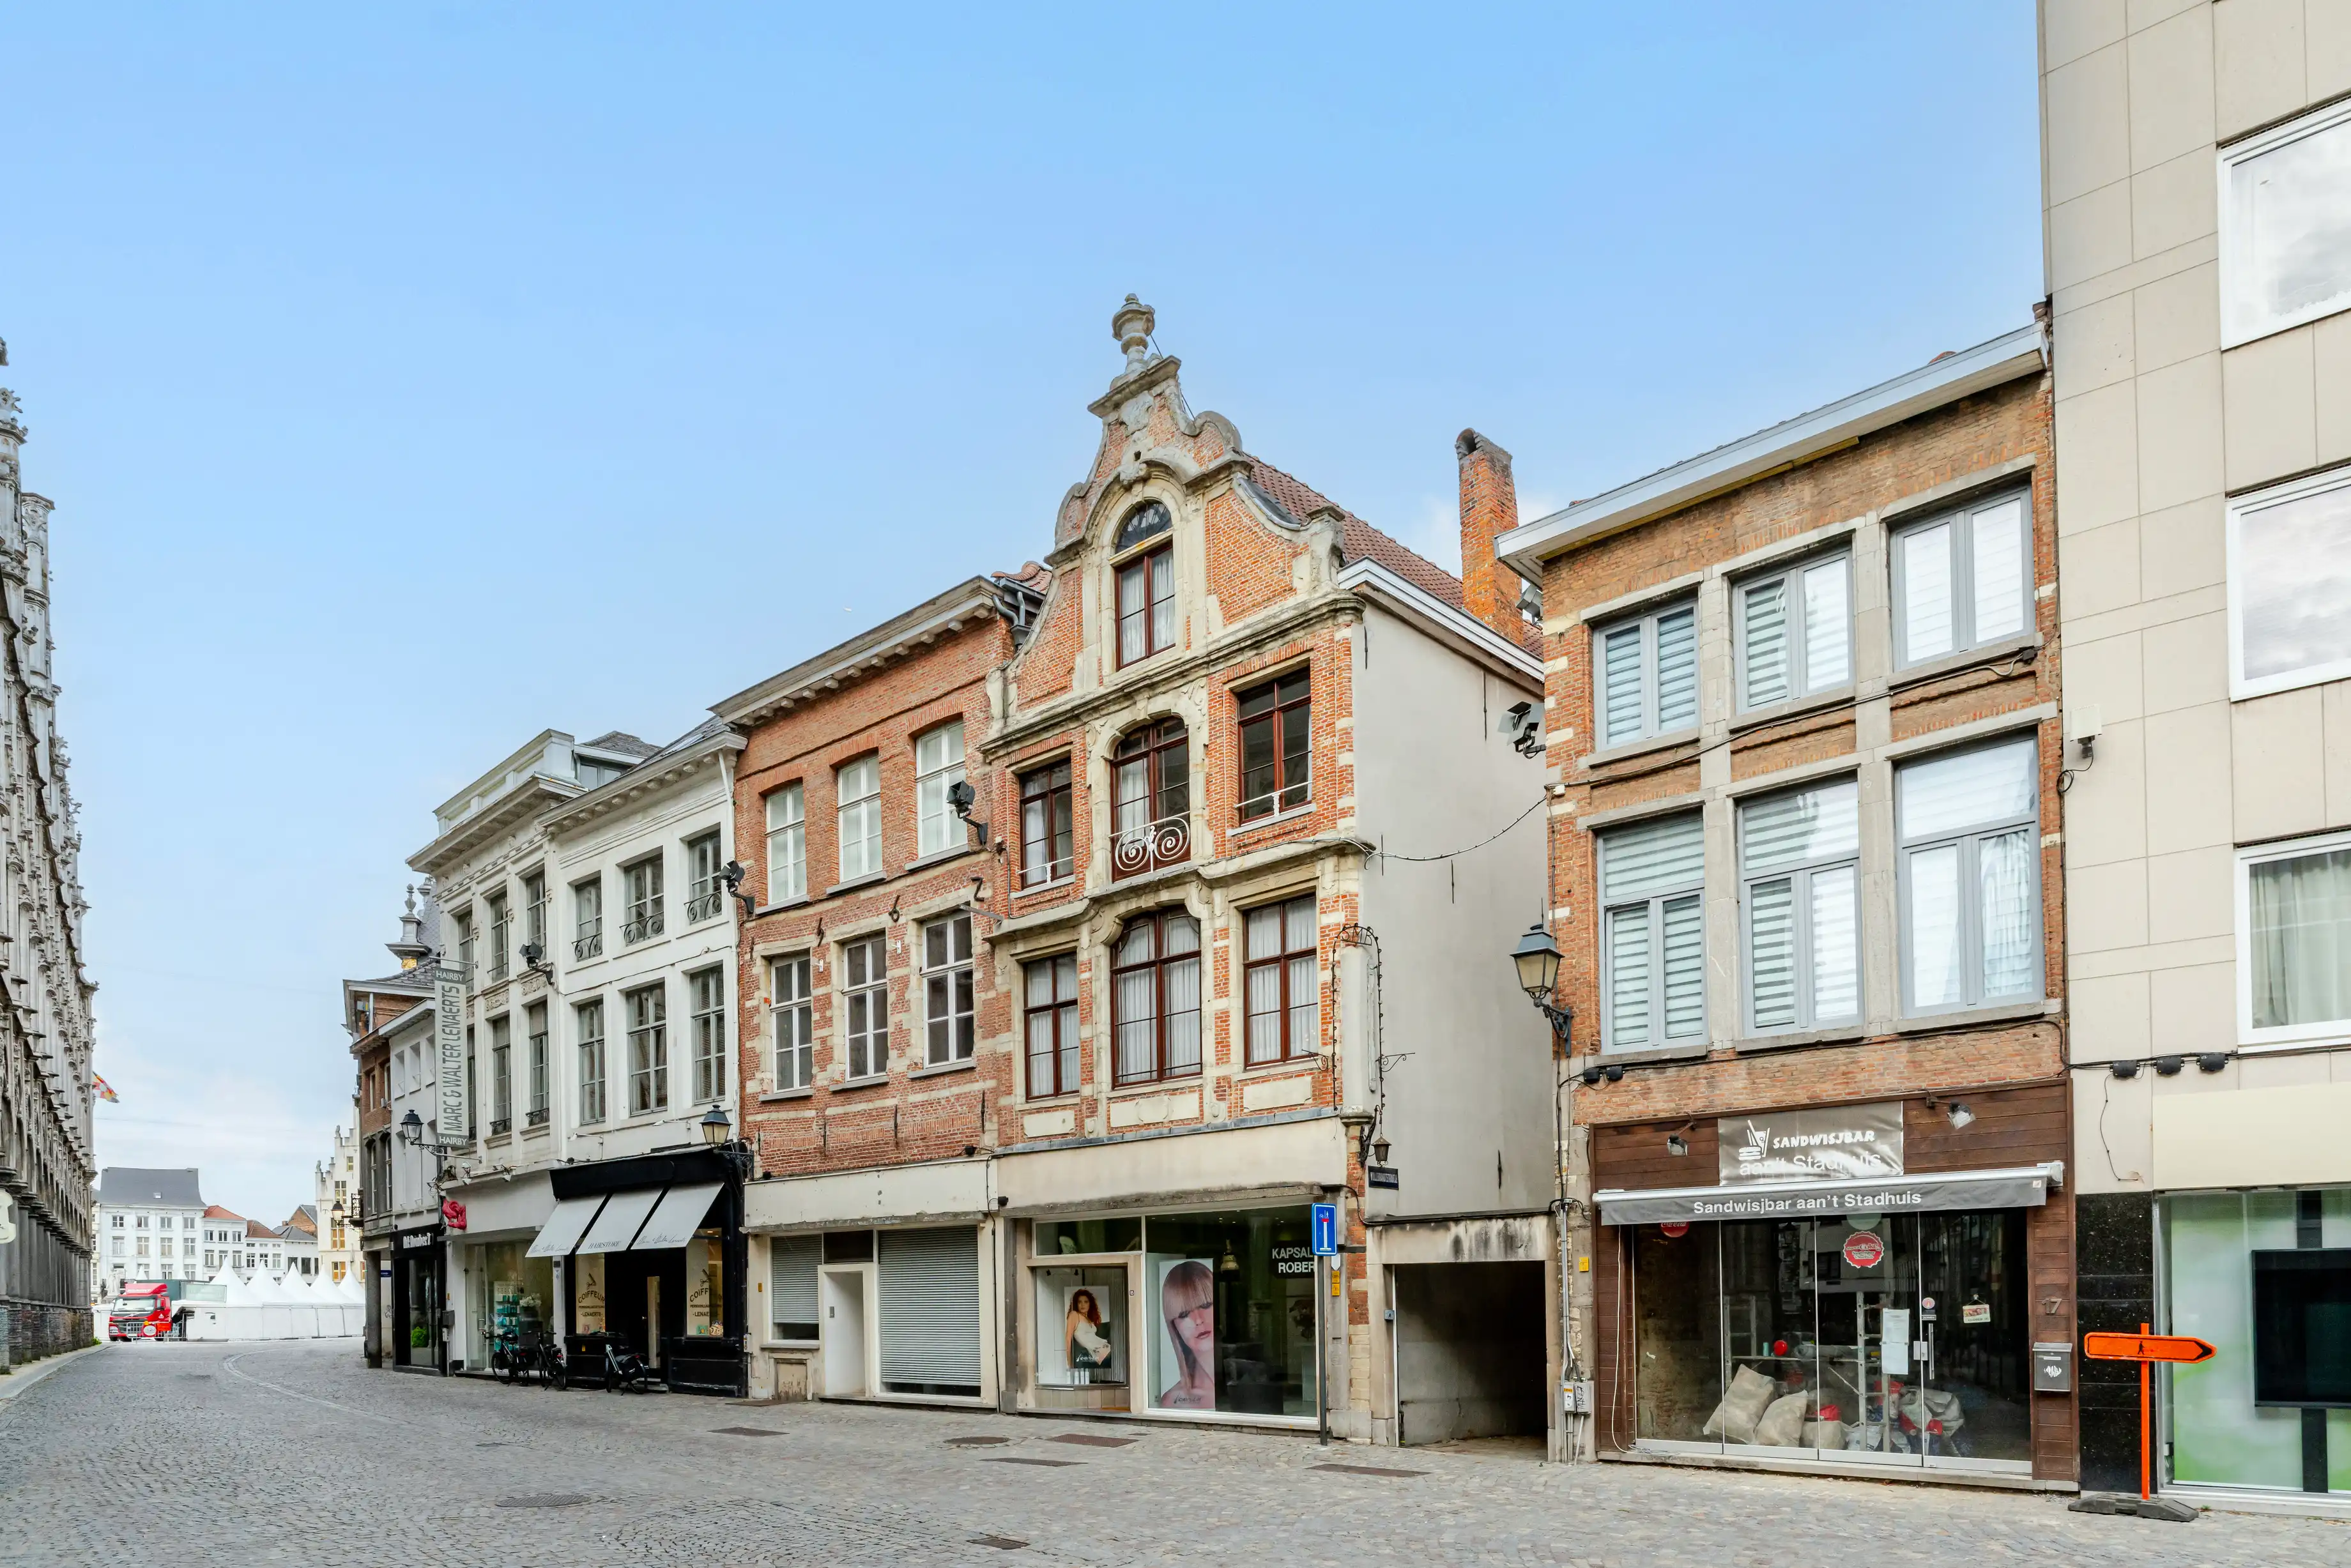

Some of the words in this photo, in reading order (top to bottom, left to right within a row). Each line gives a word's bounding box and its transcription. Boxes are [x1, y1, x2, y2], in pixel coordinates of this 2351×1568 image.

[436, 971, 464, 982] HAIRBY
[441, 985, 461, 1041] LENAERTS
[442, 1044, 461, 1088] WALTER
[442, 1090, 462, 1098] &
[443, 1100, 463, 1132] MARC
[439, 1136, 468, 1146] HAIRBY
[1773, 1130, 1876, 1149] SANDWISJBAR
[1694, 1198, 1791, 1214] Sandwisjbar
[1844, 1191, 1922, 1207] Stadhuis
[578, 1290, 605, 1305] COIFFEUR
[2041, 1298, 2063, 1314] 17
